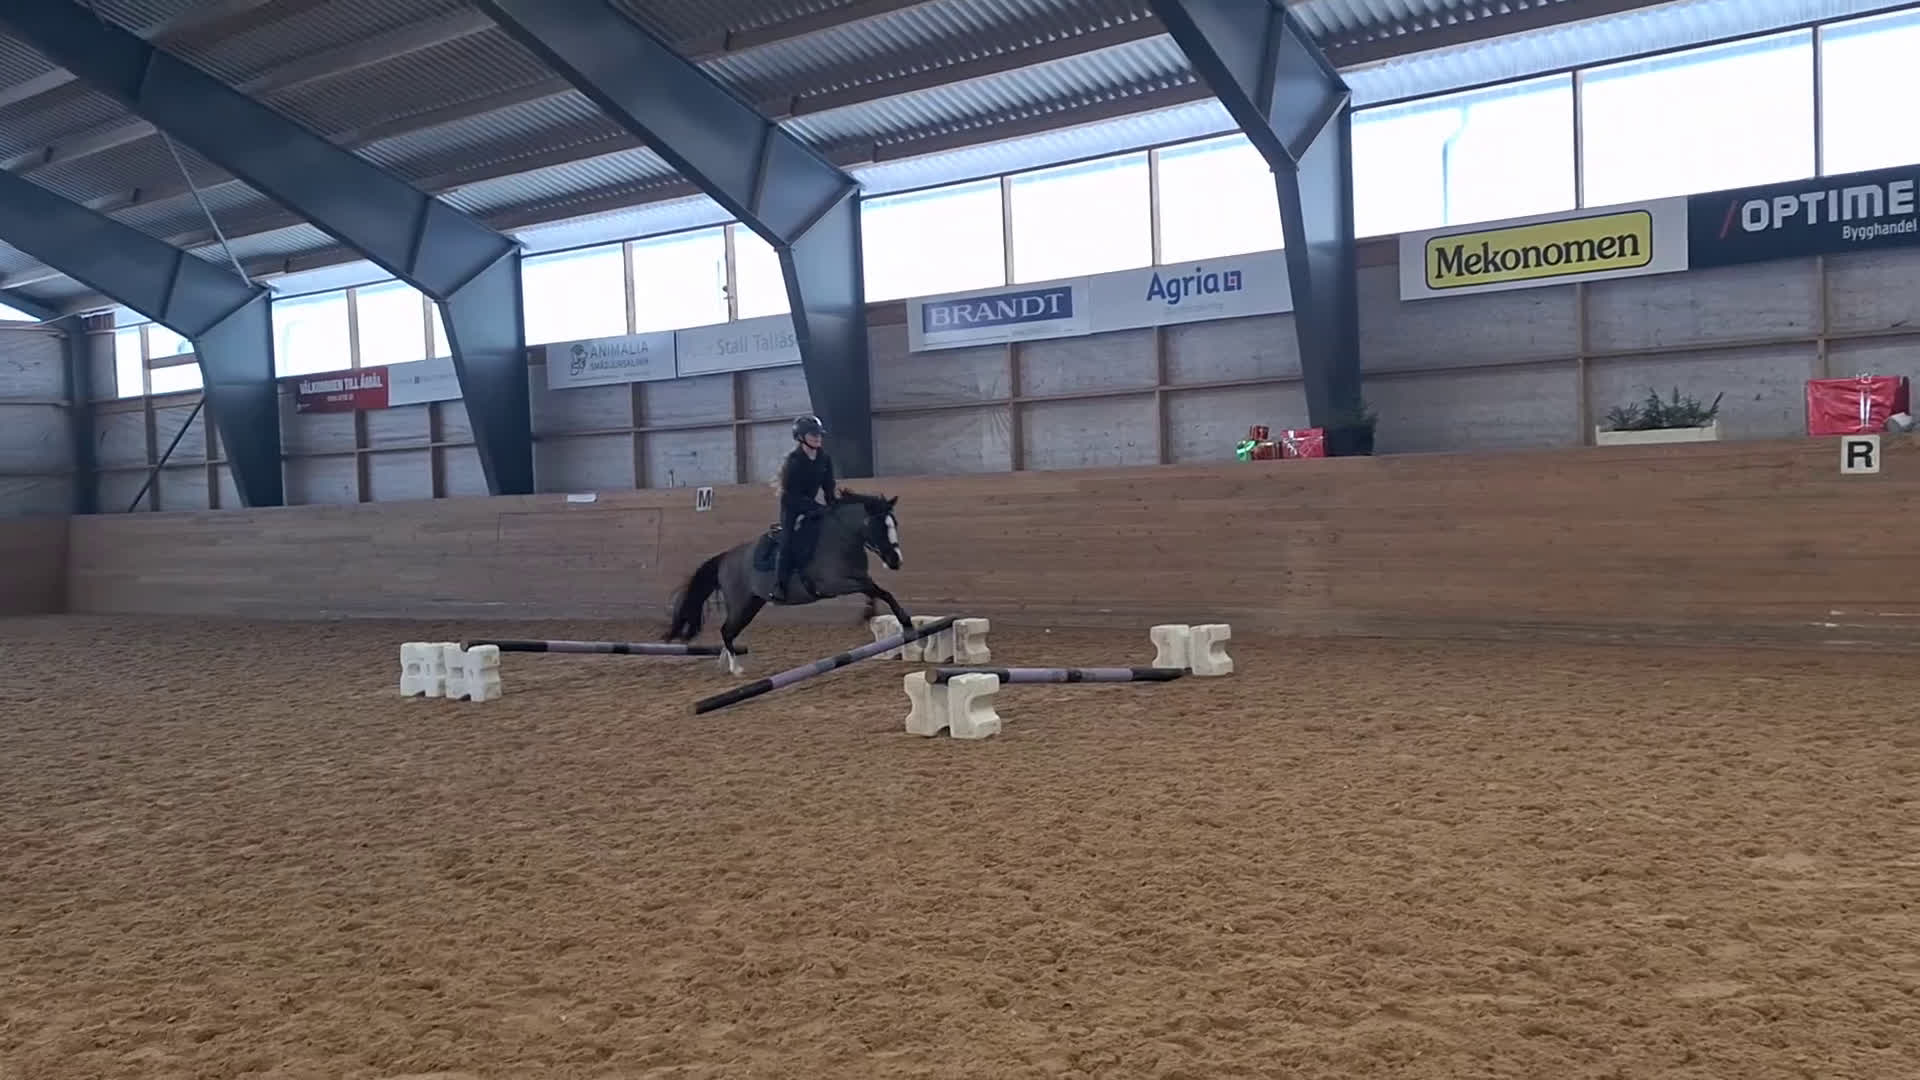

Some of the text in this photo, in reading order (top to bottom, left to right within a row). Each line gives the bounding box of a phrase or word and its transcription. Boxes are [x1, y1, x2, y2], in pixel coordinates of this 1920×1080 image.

[1741, 180, 1920, 232] OPTIME
[1842, 218, 1917, 240] Bygghandel
[1435, 233, 1640, 279] Mekonomen
[1146, 267, 1220, 305] Agria
[930, 293, 1064, 327] BRANDT
[590, 341, 648, 359] ANIMALIA
[717, 335, 748, 356] Stall
[1848, 441, 1873, 468] R
[698, 489, 711, 508] M
